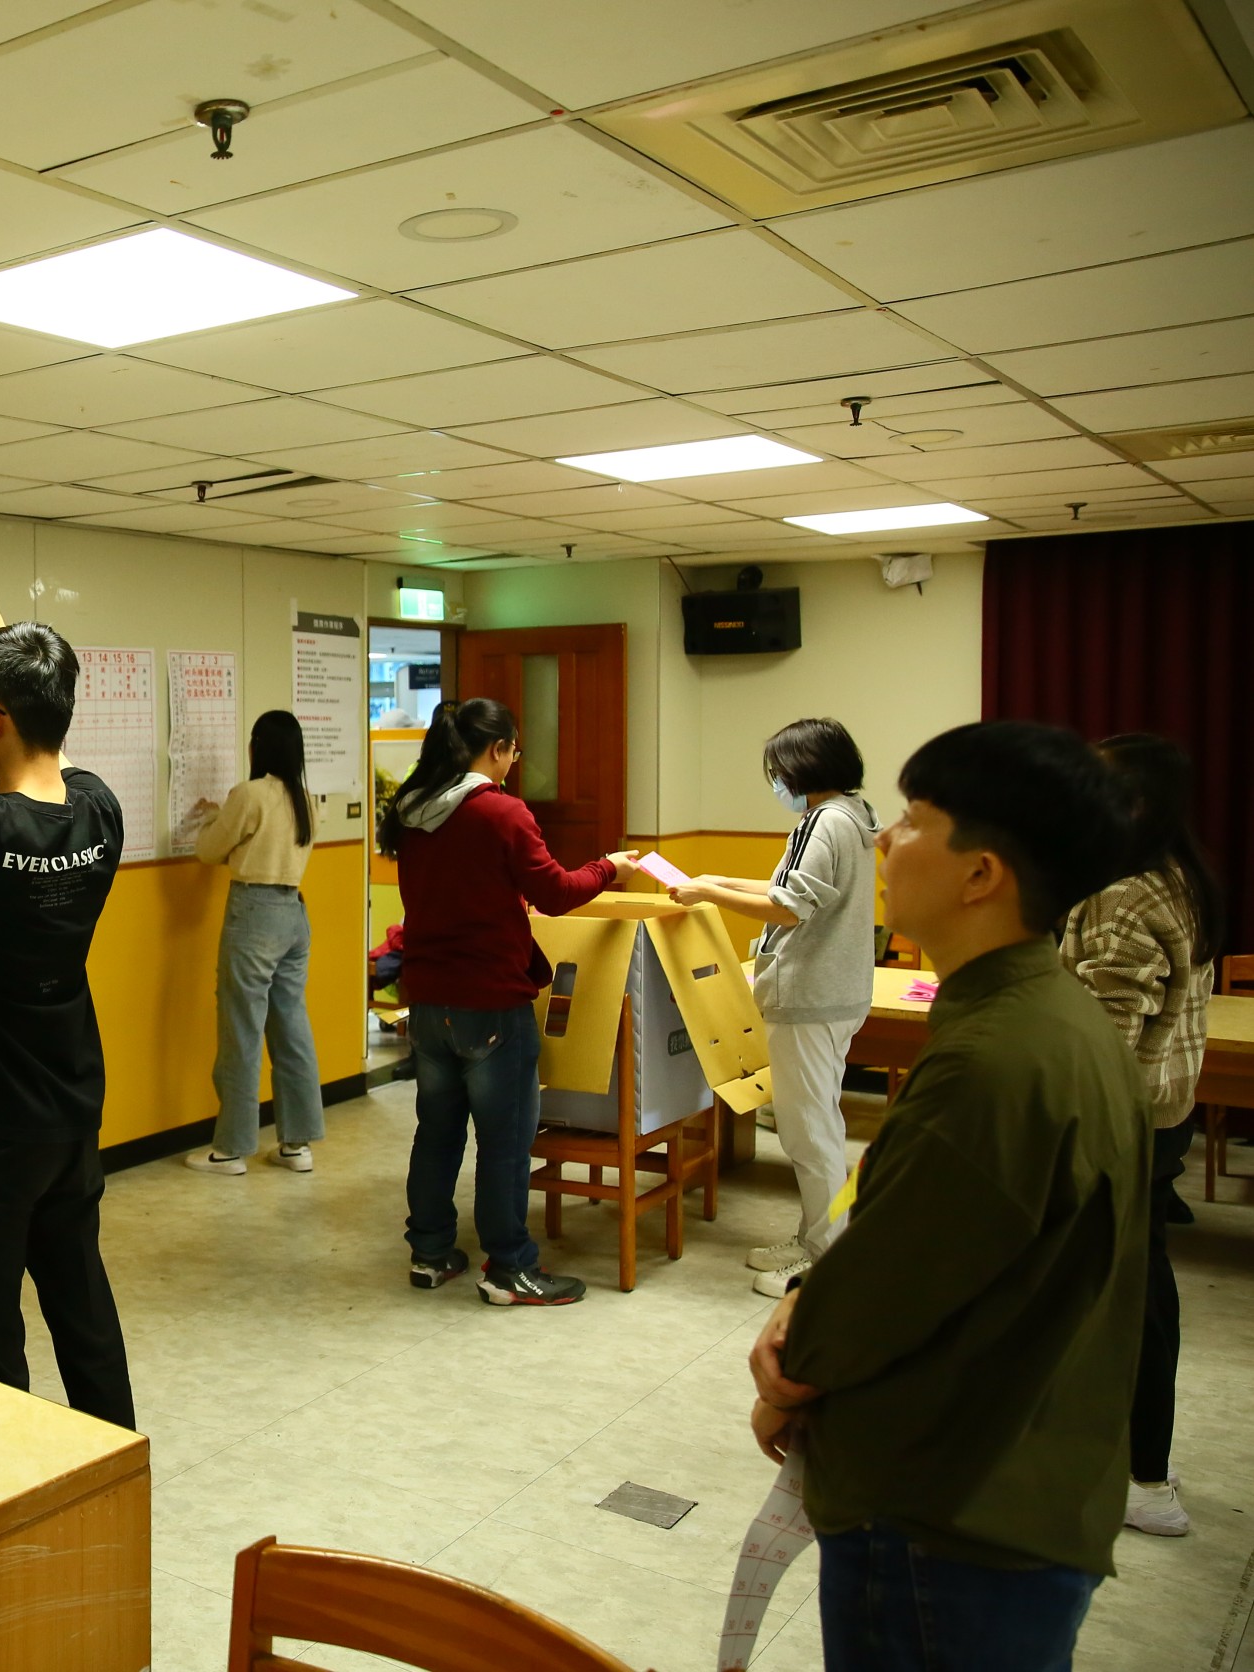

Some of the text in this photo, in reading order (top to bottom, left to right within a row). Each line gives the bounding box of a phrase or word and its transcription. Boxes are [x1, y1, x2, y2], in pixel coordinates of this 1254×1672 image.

[82, 653, 92, 663] 13
[98, 653, 108, 663] 14
[113, 653, 122, 663] 15
[126, 653, 135, 664] 16
[187, 656, 192, 664] 1
[200, 656, 206, 665] 2
[213, 656, 218, 665] 3
[789, 1478, 801, 1491] 10
[770, 1514, 783, 1524] 15
[748, 1543, 760, 1553] 20
[773, 1549, 787, 1560] 70
